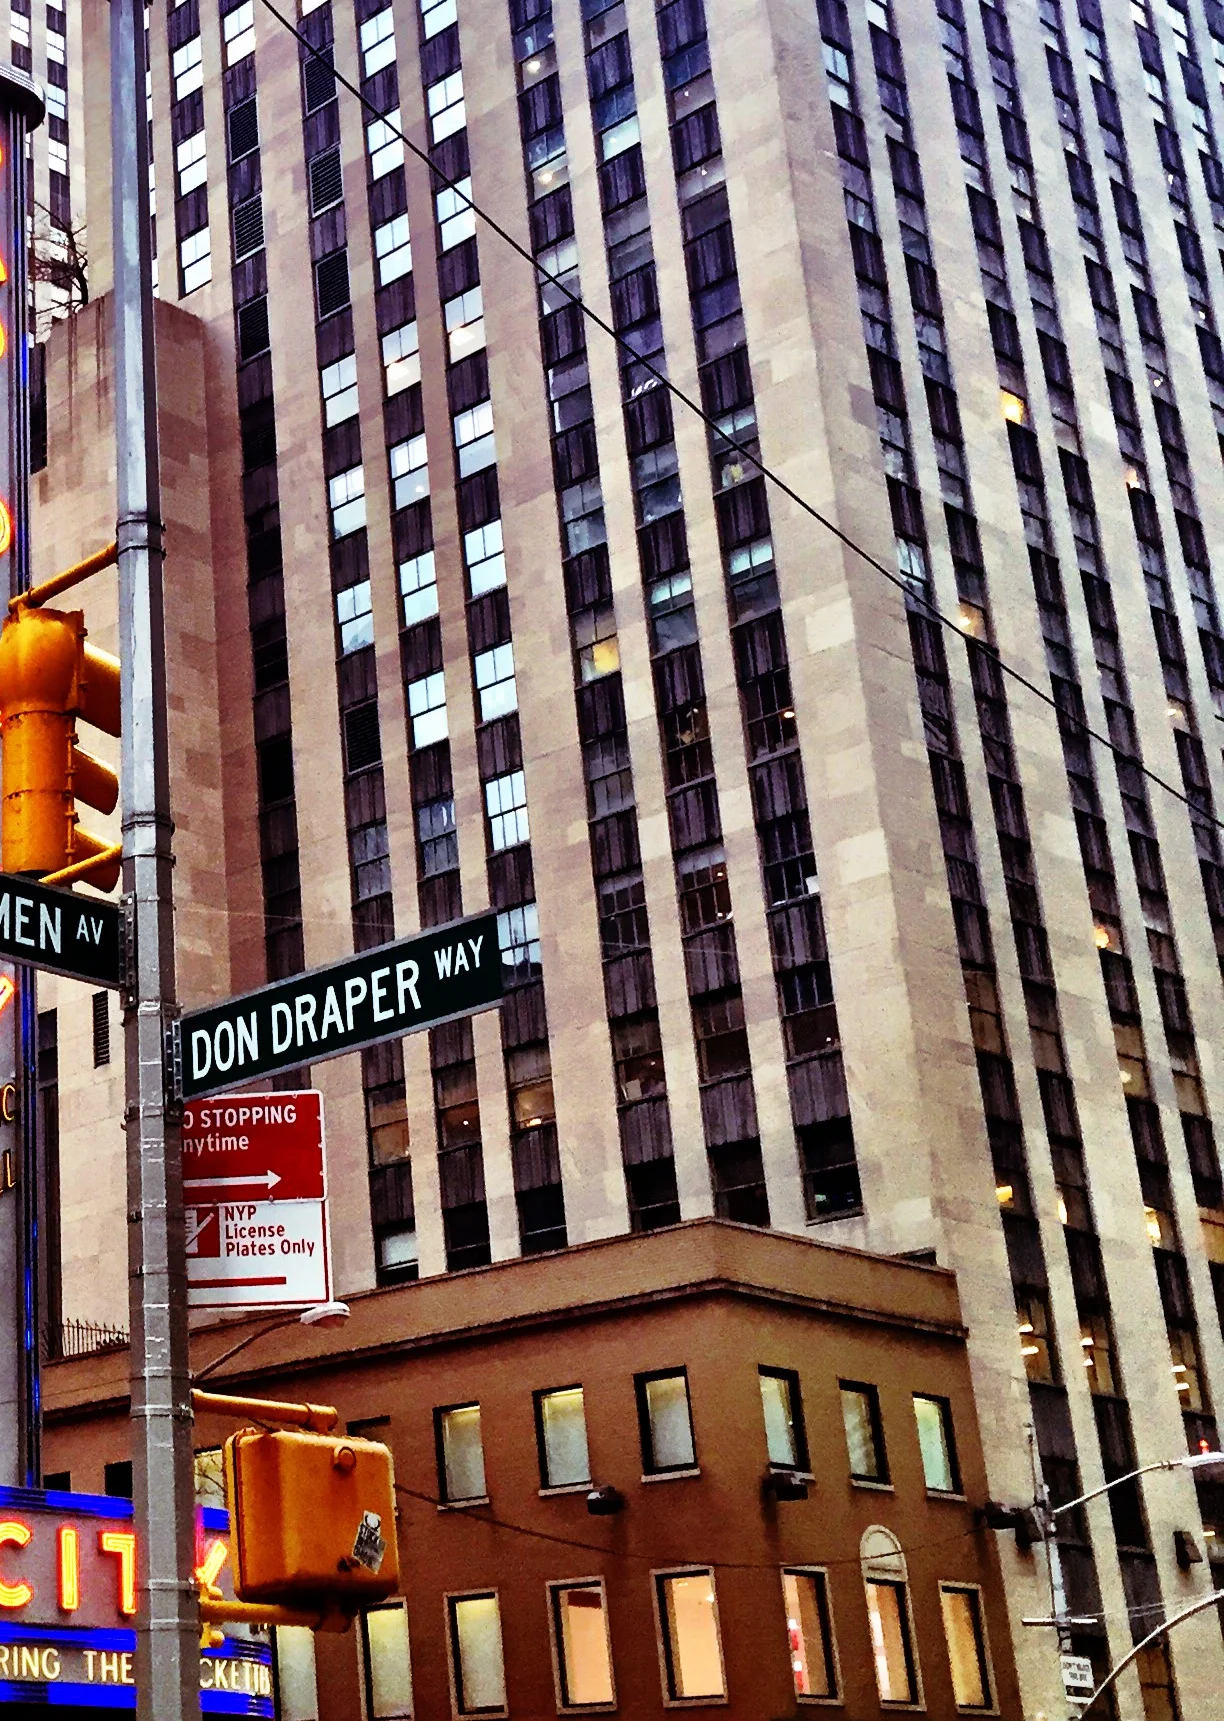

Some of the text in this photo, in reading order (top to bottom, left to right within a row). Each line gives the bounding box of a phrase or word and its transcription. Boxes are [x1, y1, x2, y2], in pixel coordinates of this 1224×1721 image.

[75, 913, 105, 947] AV
[190, 934, 486, 1081] DON DRAPER WAY
[183, 1104, 298, 1130] O STOPPING
[183, 1132, 250, 1157] nytime
[225, 1204, 258, 1222] NYP
[225, 1224, 286, 1240] License
[225, 1238, 316, 1257] Plates Only
[82, 1649, 137, 1685] THE
